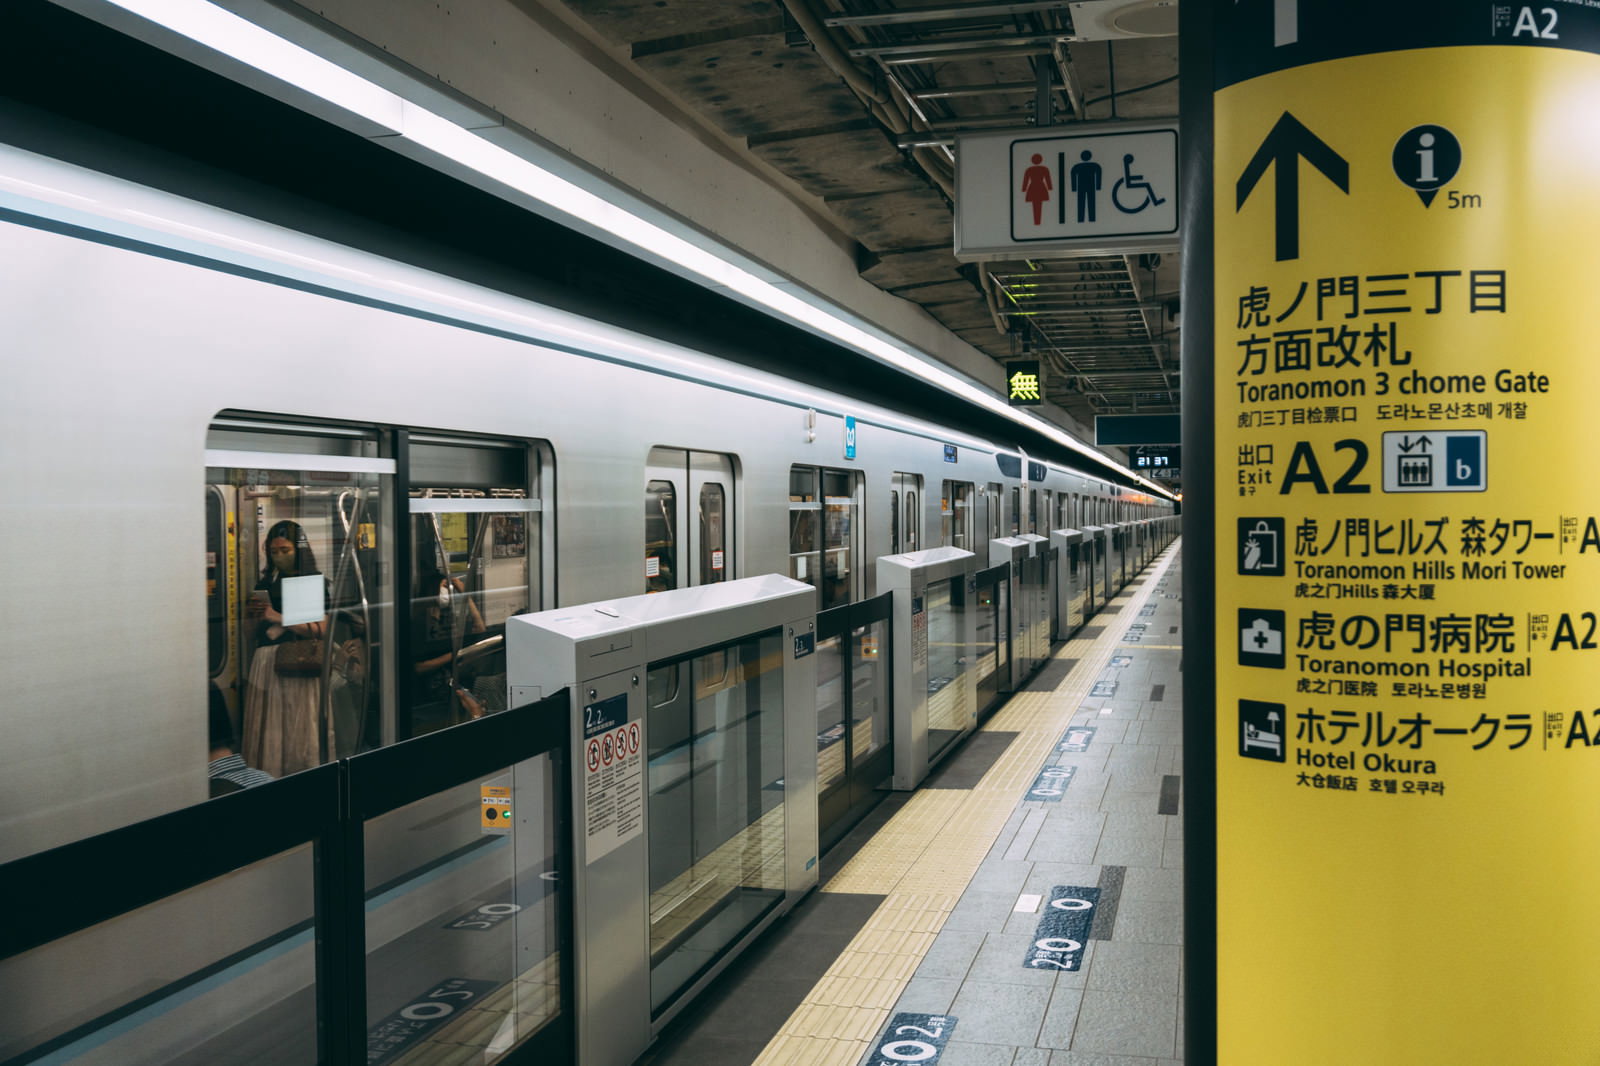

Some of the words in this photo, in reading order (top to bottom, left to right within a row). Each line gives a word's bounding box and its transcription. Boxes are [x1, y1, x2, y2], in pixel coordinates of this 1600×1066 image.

[1512, 6, 1559, 39] A2
[1447, 190, 1482, 209] 5m
[1237, 269, 1506, 329] 虎ノ門三丁目
[1237, 322, 1412, 376] 方面改札
[1237, 378, 1366, 403] Toranomon
[1375, 372, 1390, 396] 3
[1399, 369, 1486, 395] chome
[1495, 369, 1550, 393] Gate
[1238, 444, 1273, 466] 出口
[1279, 438, 1371, 495] A2
[1238, 468, 1272, 484] Exit
[1294, 517, 1449, 557] 虎ノ門ヒルズ
[1460, 516, 1555, 557] 森タワー
[1294, 560, 1405, 579] Toranomon
[1413, 560, 1455, 580] Hills
[1462, 560, 1507, 580] Mori
[1512, 561, 1566, 579] Tower
[1296, 610, 1515, 654] 虎の門病院
[1550, 611, 1598, 651] A2
[1296, 654, 1430, 677] Toranomon
[1438, 657, 1531, 682] Hospital
[1296, 707, 1532, 750] ホテルオークラ
[1296, 747, 1355, 770] Hotel
[1363, 753, 1437, 774] Okura
